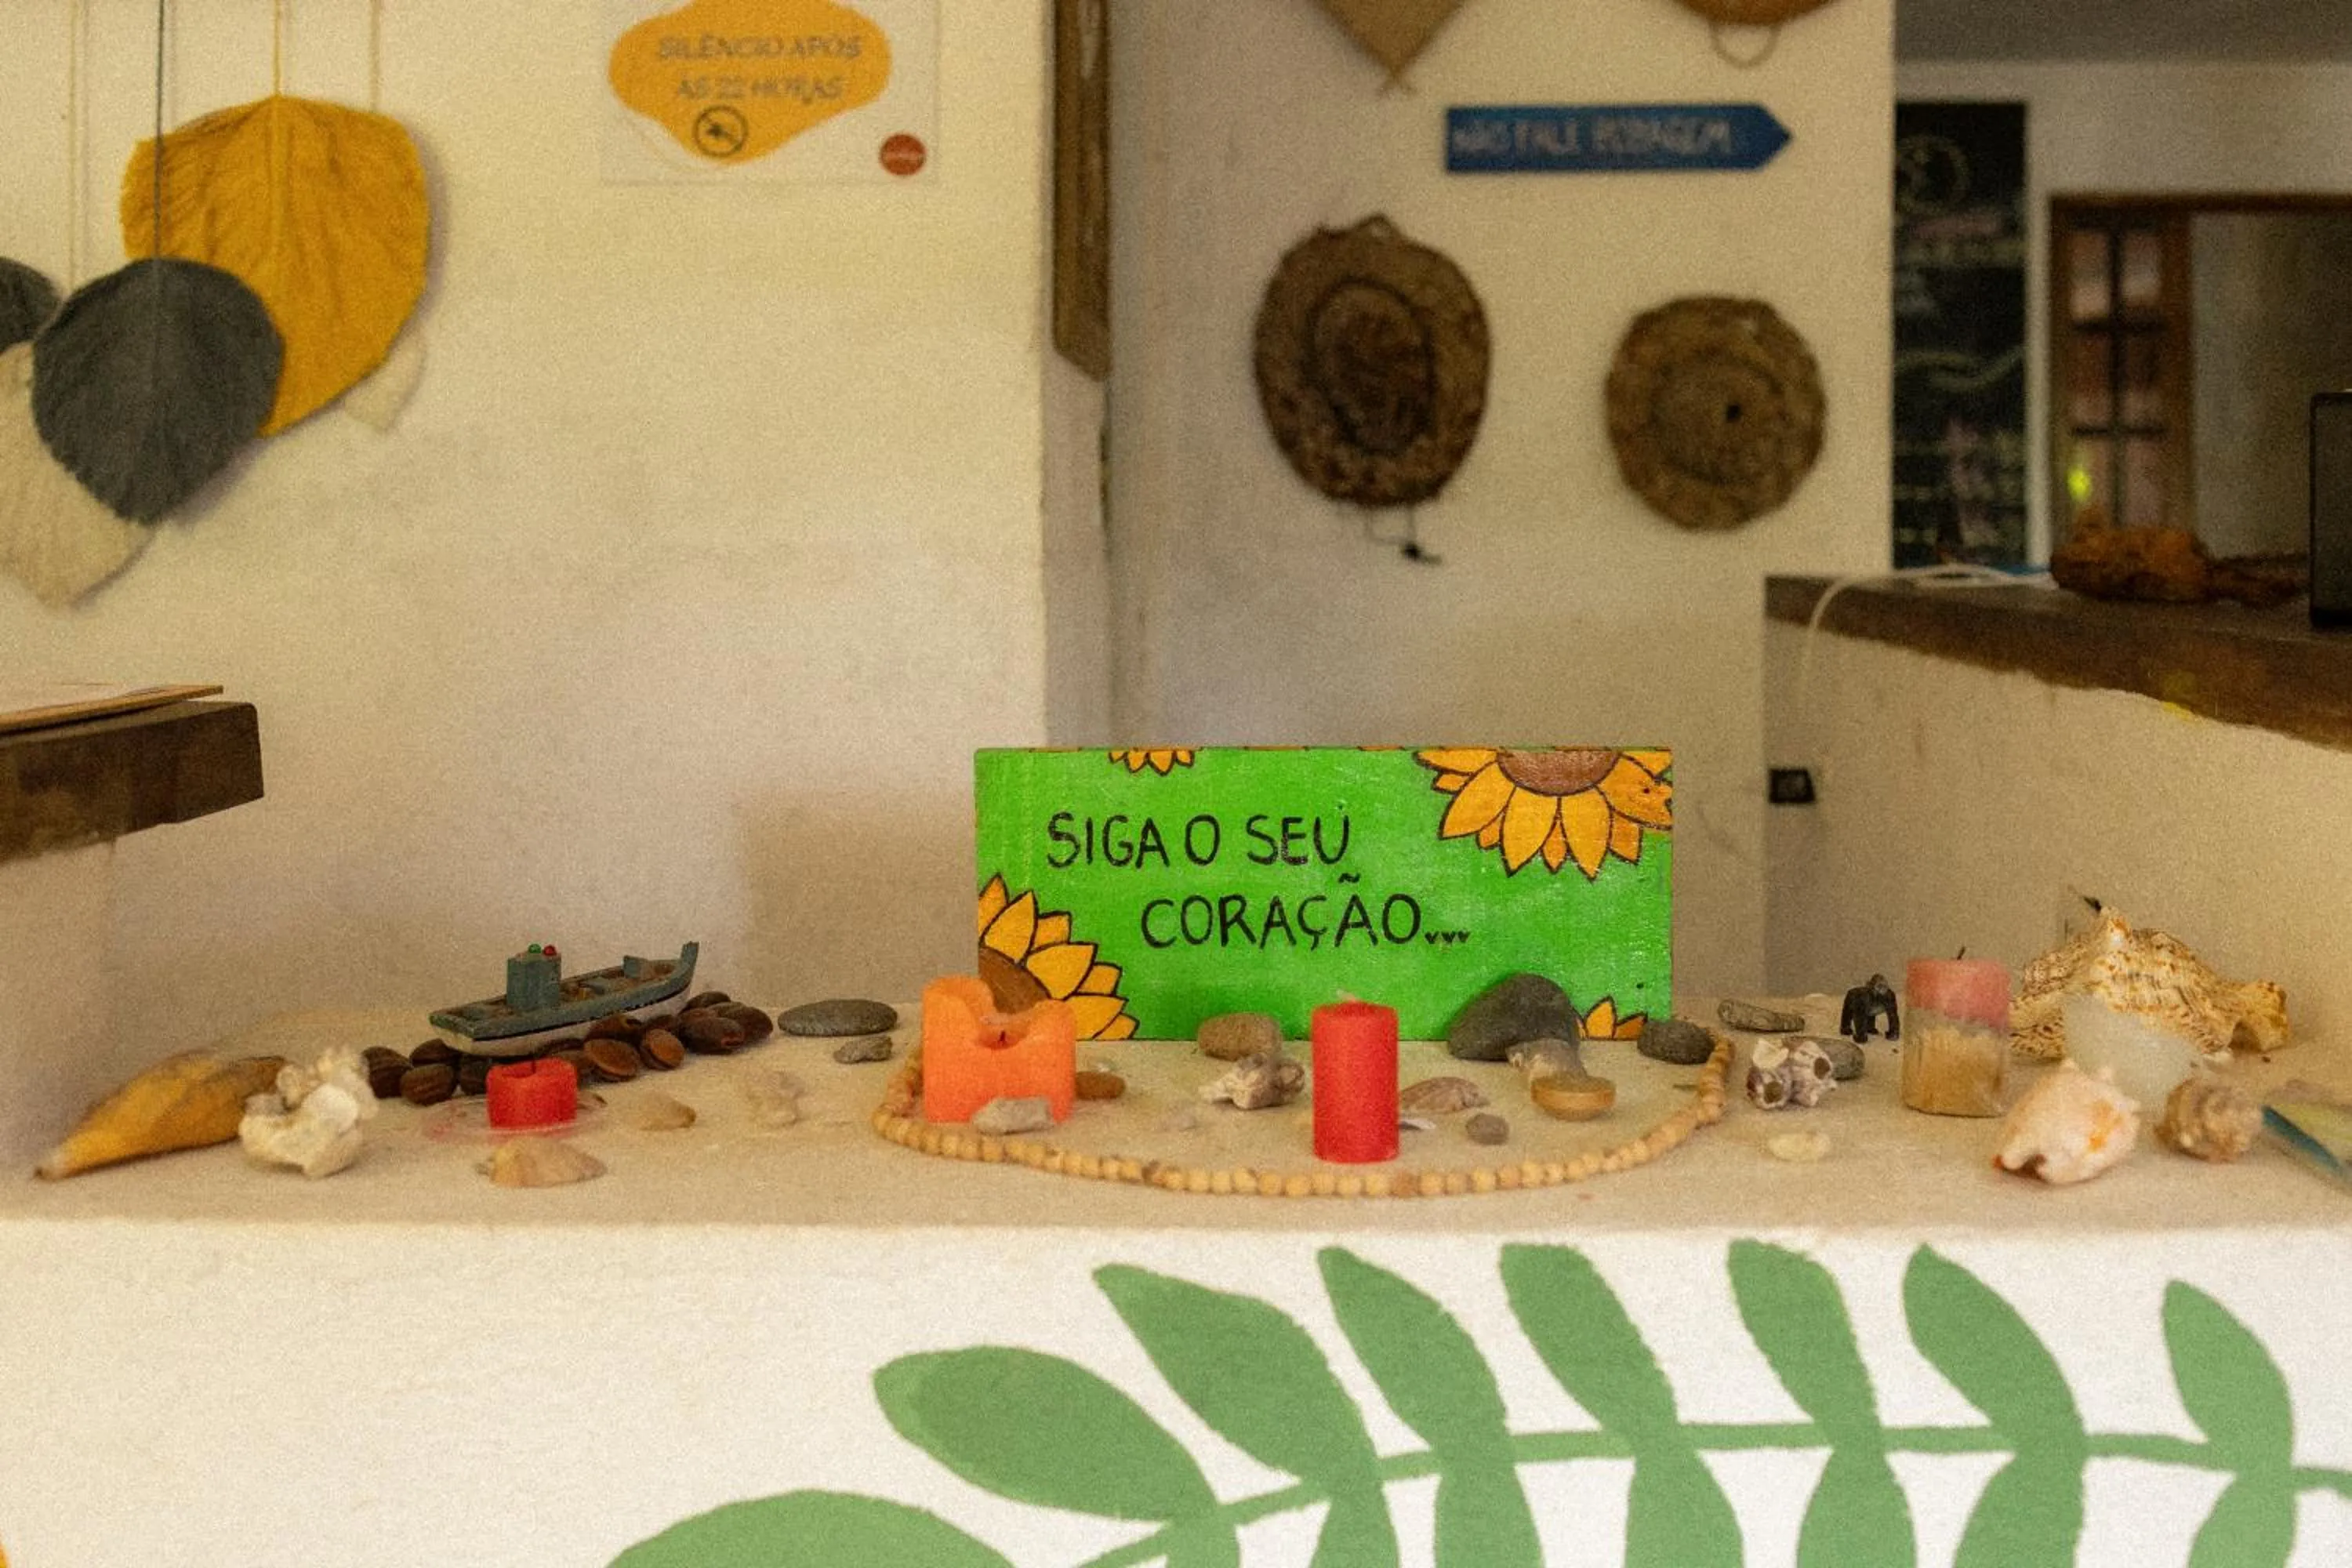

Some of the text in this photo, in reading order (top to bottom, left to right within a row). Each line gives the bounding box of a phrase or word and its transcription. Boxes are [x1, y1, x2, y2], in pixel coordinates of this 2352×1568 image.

[1047, 811, 1350, 869] SIGA O SEU
